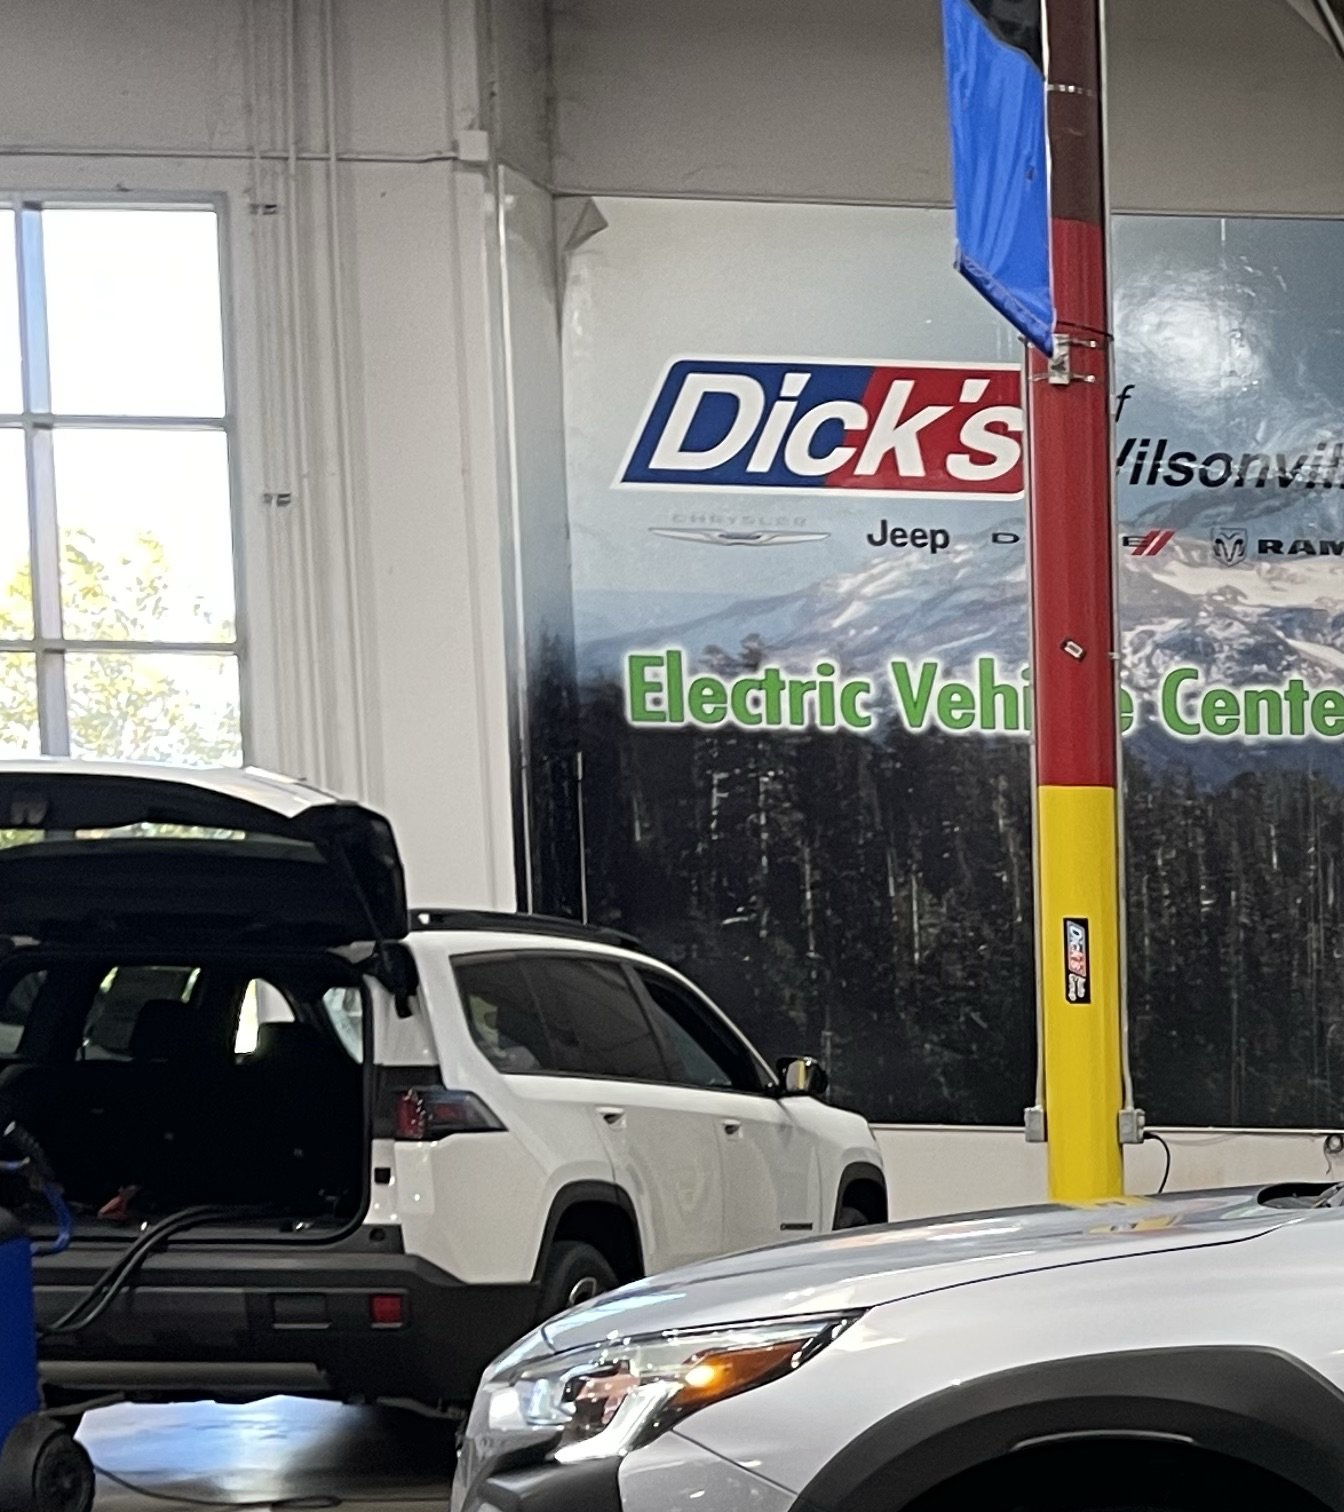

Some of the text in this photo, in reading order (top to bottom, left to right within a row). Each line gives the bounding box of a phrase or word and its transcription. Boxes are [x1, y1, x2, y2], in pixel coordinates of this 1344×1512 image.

[648, 372, 1025, 481] Dick's
[1115, 384, 1136, 423] f
[867, 519, 950, 554] Jeep
[628, 649, 872, 728] Electric
[888, 657, 1134, 733] Vehi
